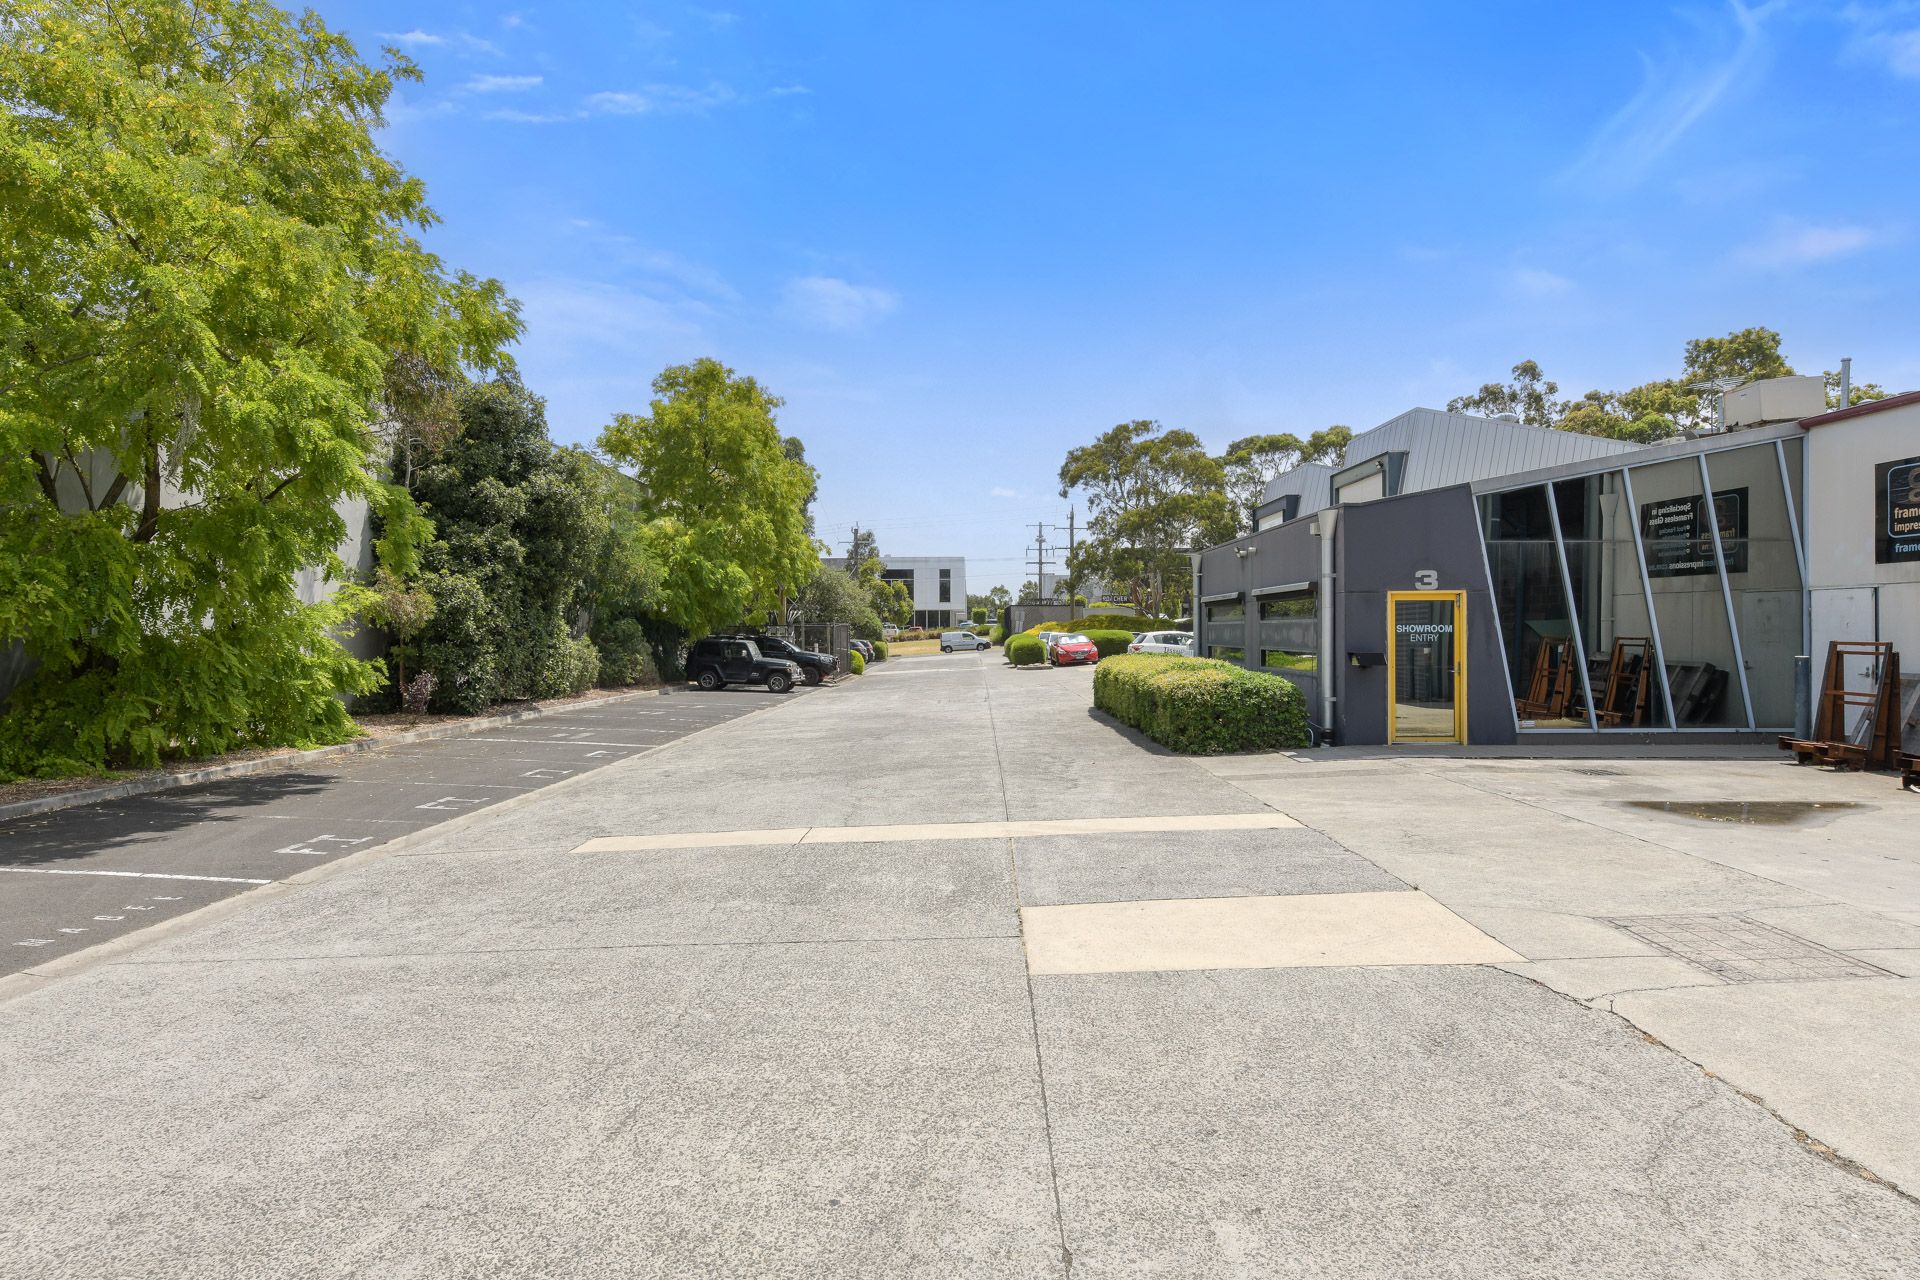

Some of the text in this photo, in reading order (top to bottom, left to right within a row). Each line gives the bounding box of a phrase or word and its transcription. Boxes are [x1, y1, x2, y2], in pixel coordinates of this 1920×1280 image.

[1894, 507, 1920, 519] fram
[1415, 570, 1438, 590] 3
[1396, 624, 1453, 633] SHOWROOM
[1410, 633, 1439, 642] ENTRY
